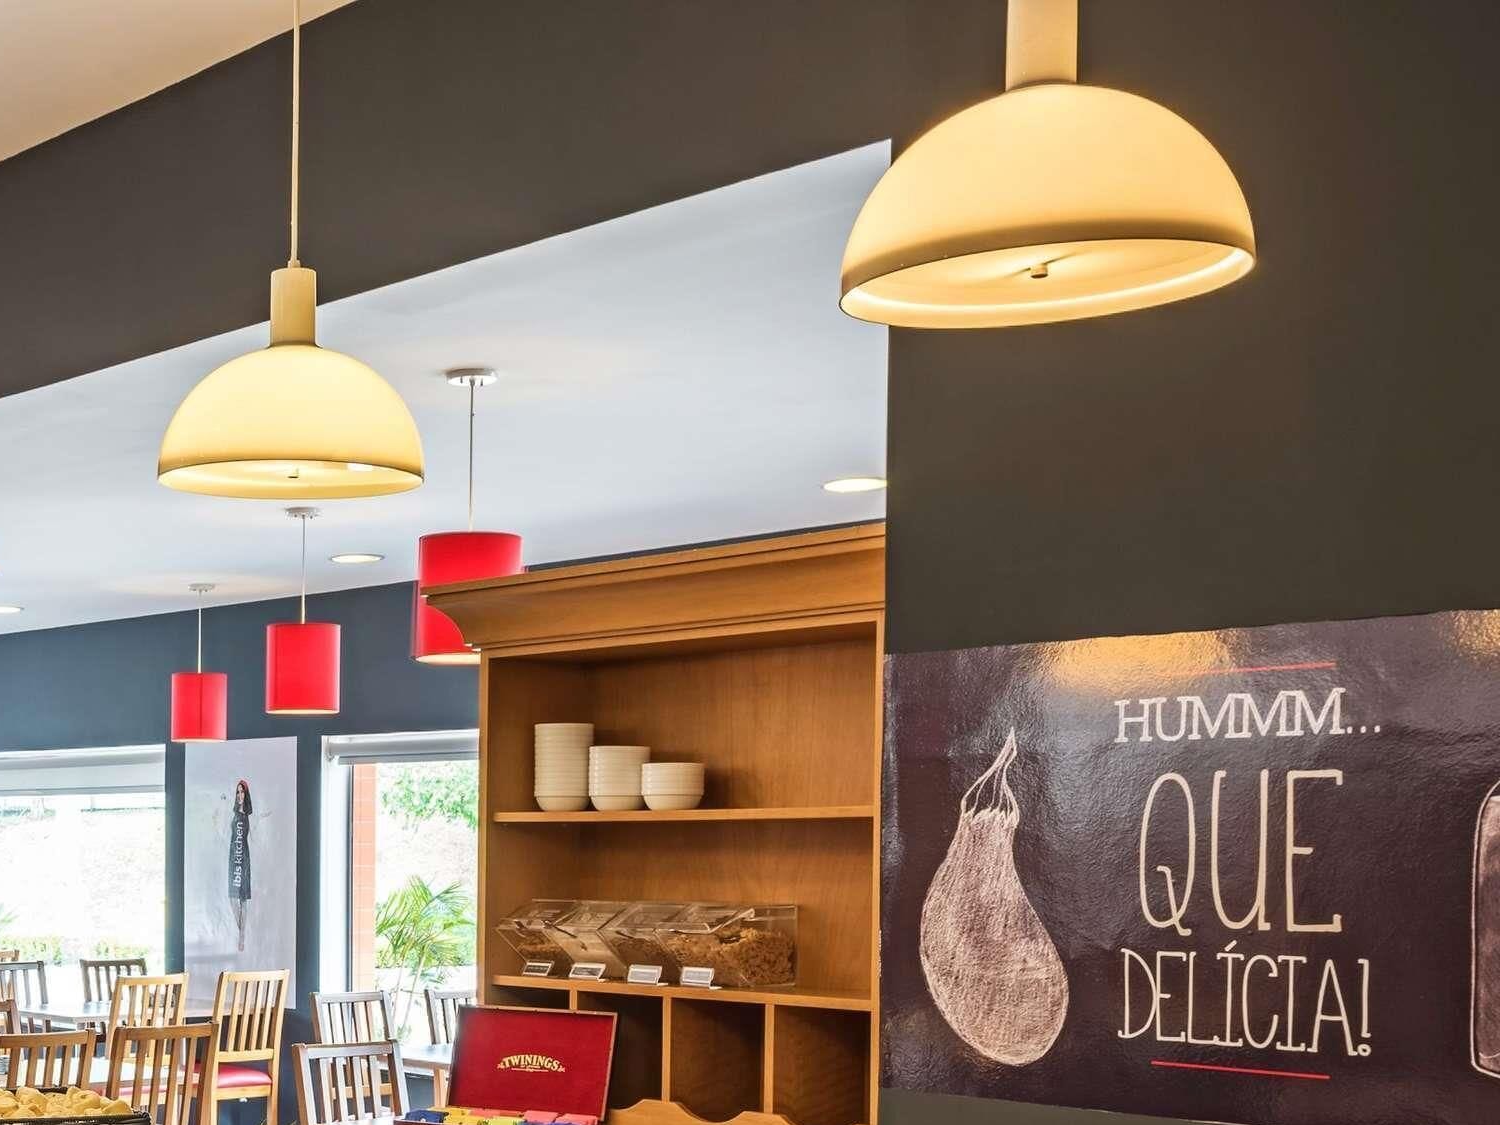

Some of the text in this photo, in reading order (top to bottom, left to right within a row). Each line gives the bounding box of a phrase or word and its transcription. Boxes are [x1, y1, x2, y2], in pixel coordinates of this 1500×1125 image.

[1114, 687, 1381, 743] HUMMM...
[1139, 768, 1345, 937] QUE
[1117, 940, 1372, 1057] DELÍCIA!
[502, 1054, 560, 1071] TWININGS
